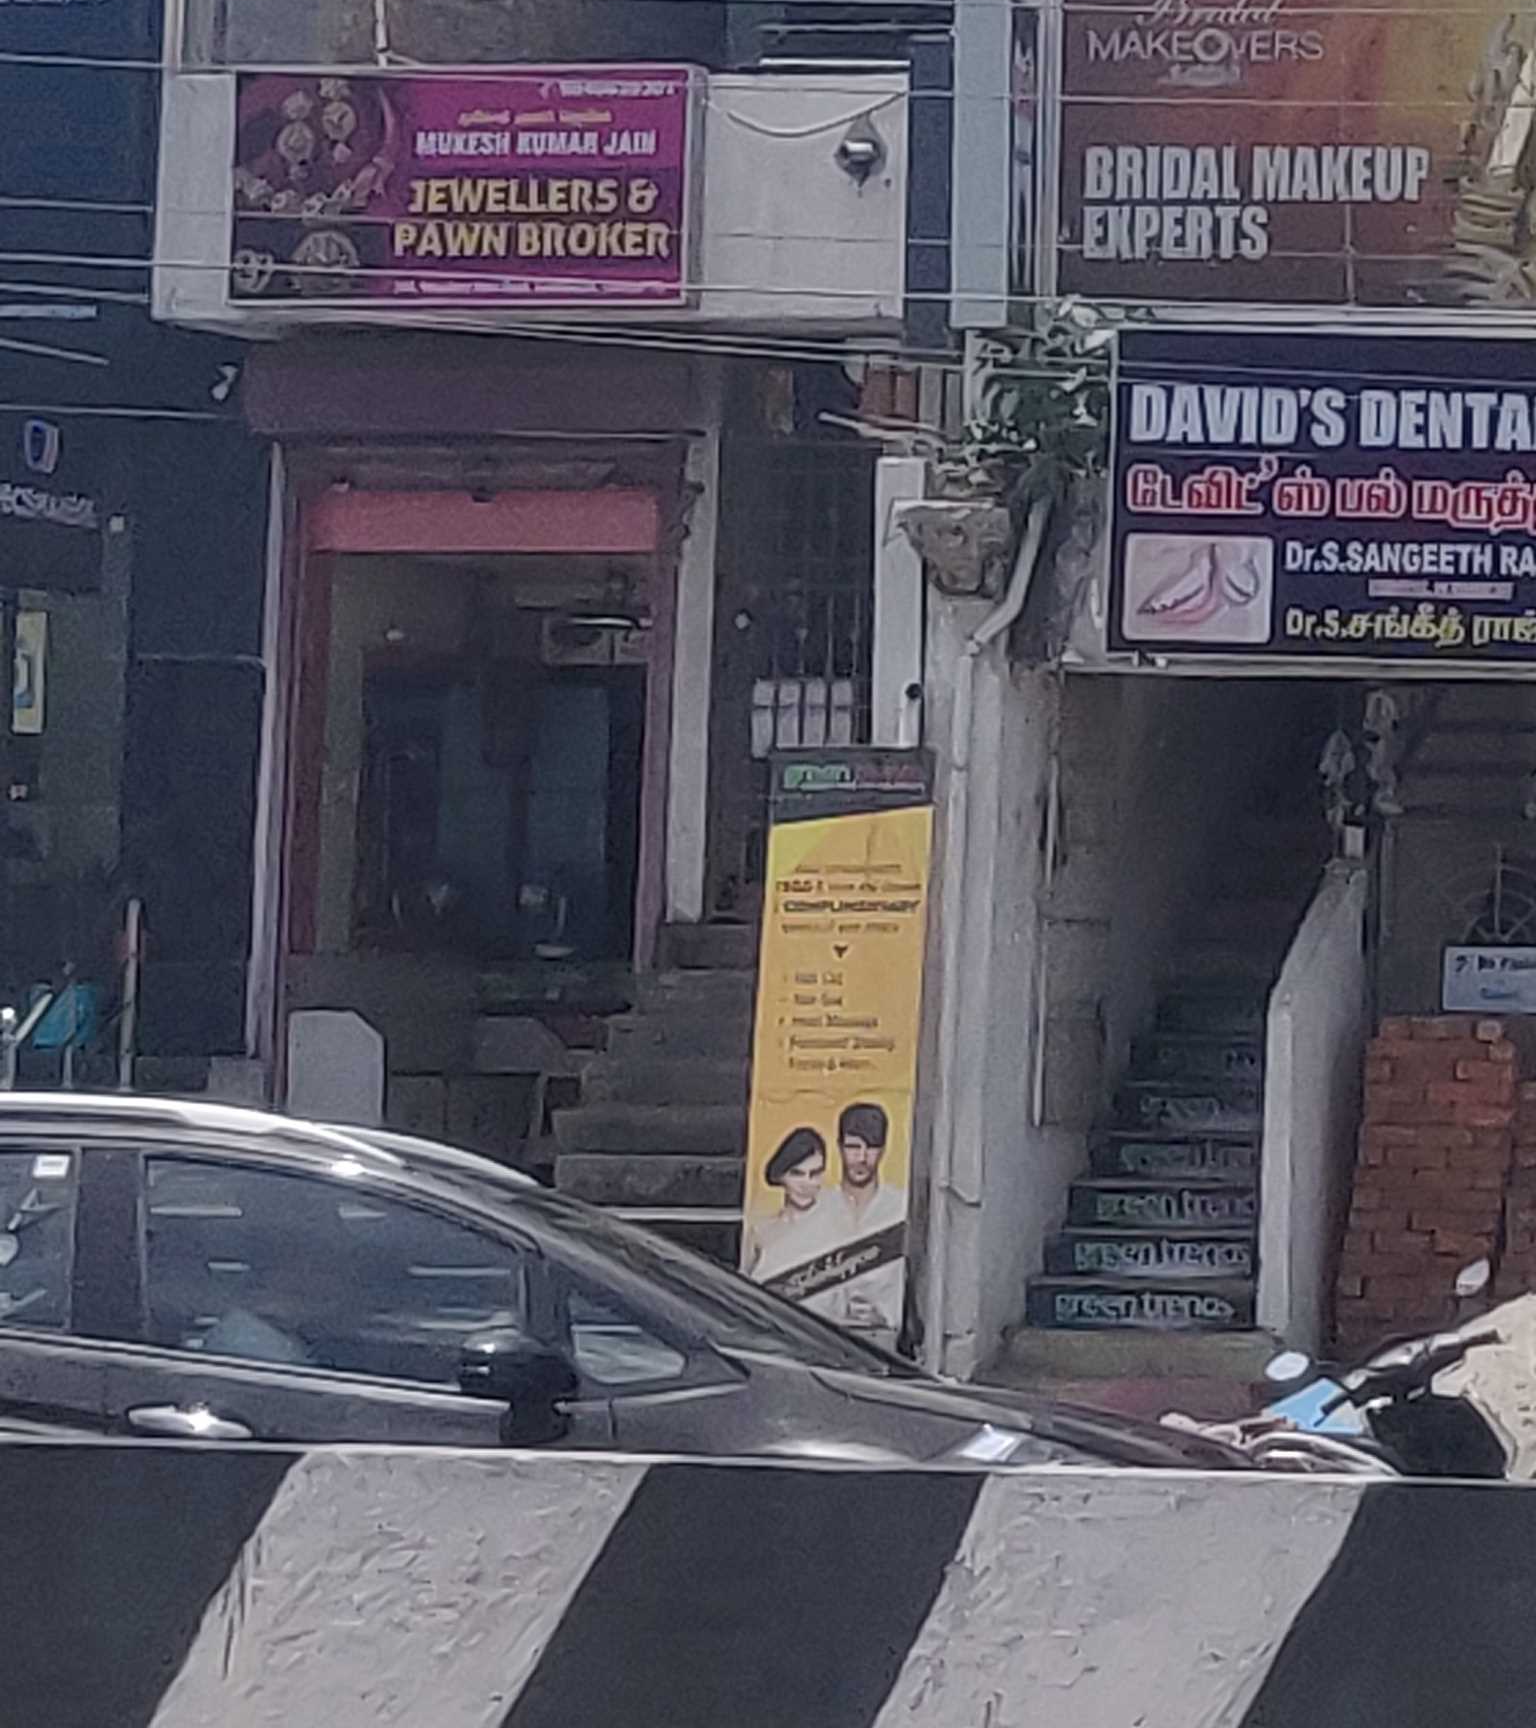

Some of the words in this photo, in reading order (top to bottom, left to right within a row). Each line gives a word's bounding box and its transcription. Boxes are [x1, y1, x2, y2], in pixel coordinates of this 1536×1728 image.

[1086, 28, 1326, 64] MAKEOVERS
[407, 177, 622, 214] JEWELLERS
[627, 180, 659, 213] &
[1083, 145, 1243, 201] BRIDAL
[1251, 145, 1431, 203] MAKEUP
[393, 221, 510, 258] PAWN
[516, 222, 672, 259] BROKER
[1081, 204, 1271, 261] EXPERTS
[1128, 383, 1347, 449] DAVID'S
